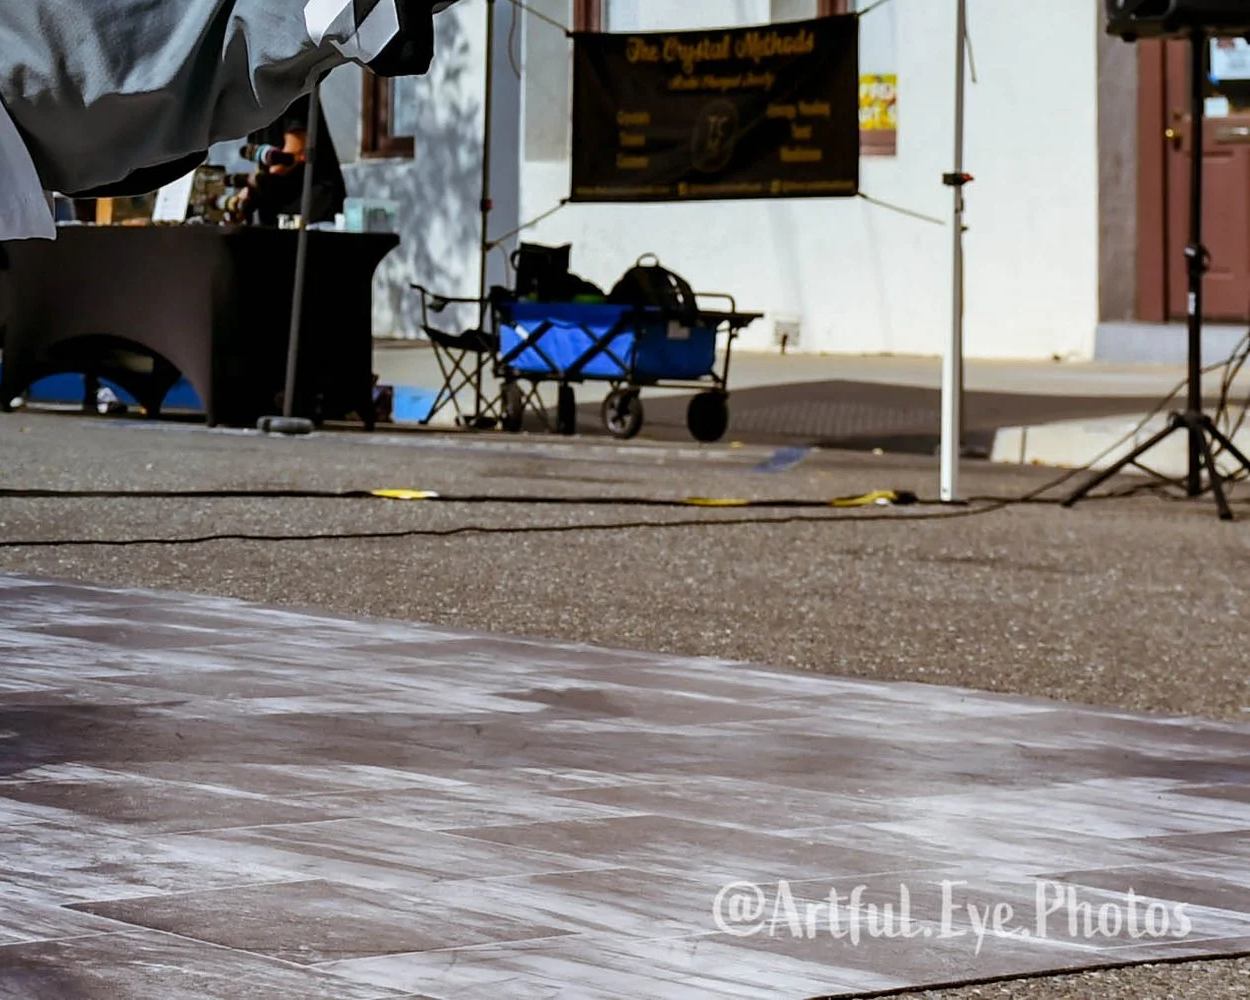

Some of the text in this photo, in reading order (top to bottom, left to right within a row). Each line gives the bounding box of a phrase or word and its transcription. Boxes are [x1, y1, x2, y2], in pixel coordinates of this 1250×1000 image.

[626, 29, 815, 74] The Crystal Methods
